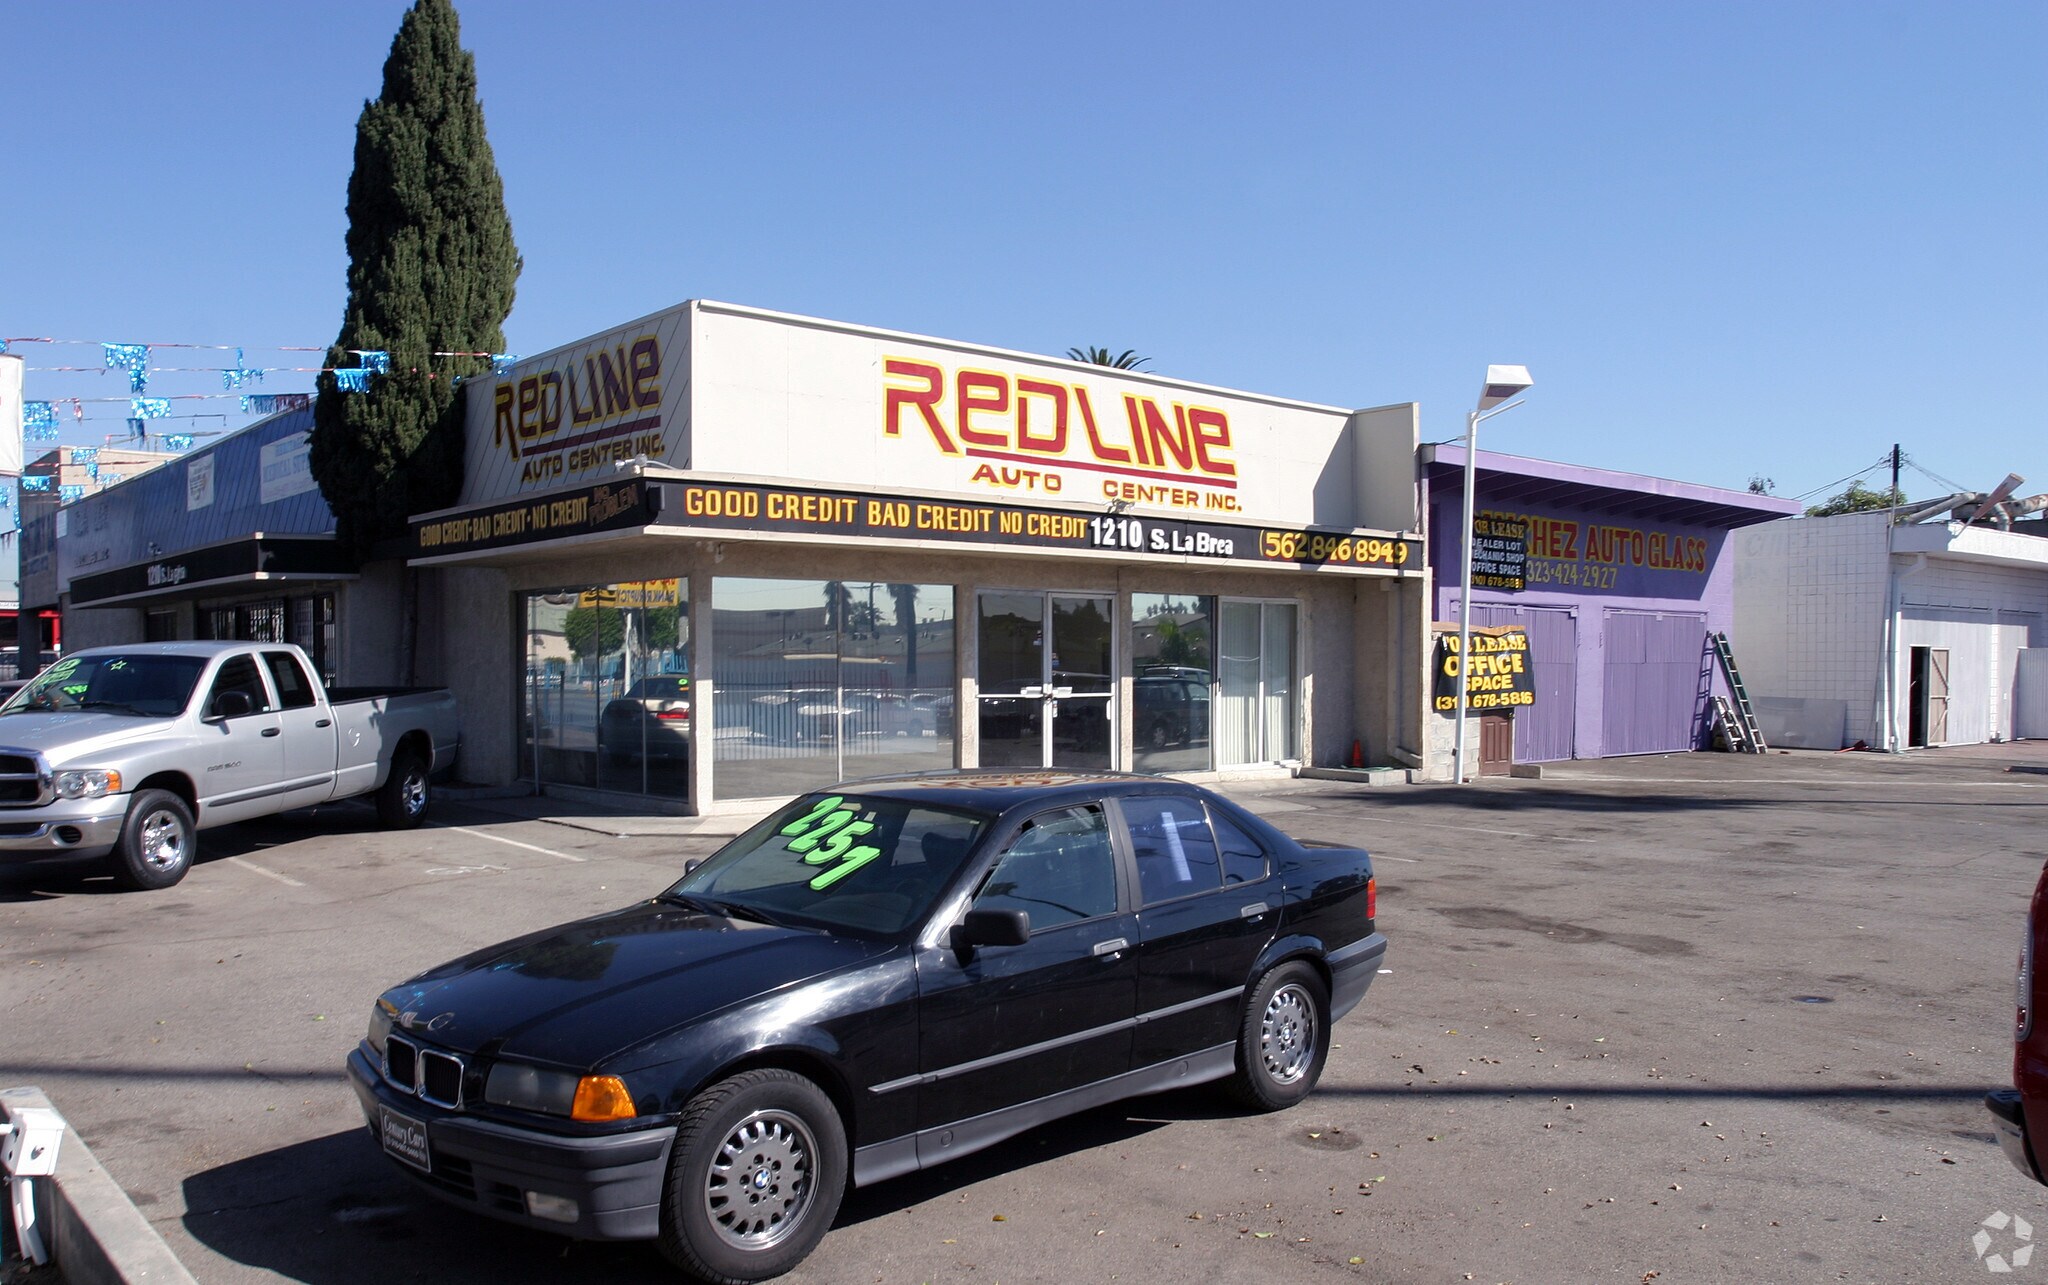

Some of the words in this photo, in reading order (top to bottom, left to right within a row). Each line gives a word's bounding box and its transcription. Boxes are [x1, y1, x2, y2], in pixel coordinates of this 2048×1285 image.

[521, 456, 563, 482] AUTO
[569, 439, 632, 474] CENTER
[971, 463, 1062, 492] AUTO
[1103, 479, 1199, 507] CENTER
[1206, 492, 1243, 512] INC.
[420, 526, 441, 547] GOOD
[472, 516, 490, 540] BAD
[493, 509, 526, 535] CREDIT
[532, 505, 547, 529] NO
[550, 496, 589, 526] CREDIT
[685, 488, 759, 518] GOOD
[767, 493, 858, 523] CREDIT
[868, 500, 911, 528] BAD
[917, 504, 994, 532] CREDIT
[1000, 508, 1022, 534] NO
[1027, 513, 1088, 539] CREDIT
[1090, 517, 1143, 548] 1210
[1150, 528, 1170, 550] S.
[1491, 521, 1525, 539] LEASE
[1472, 549, 1505, 562] ECHANIC
[1506, 552, 1525, 563] SHOP
[1506, 541, 1522, 551] LOT
[1584, 524, 1643, 566] AUTO
[1649, 532, 1707, 573] GLASS
[1499, 564, 1522, 576] SPACE
[1474, 634, 1527, 652] LEASE
[1444, 653, 1524, 677] OFFICE
[1436, 696, 1470, 710] (31)
